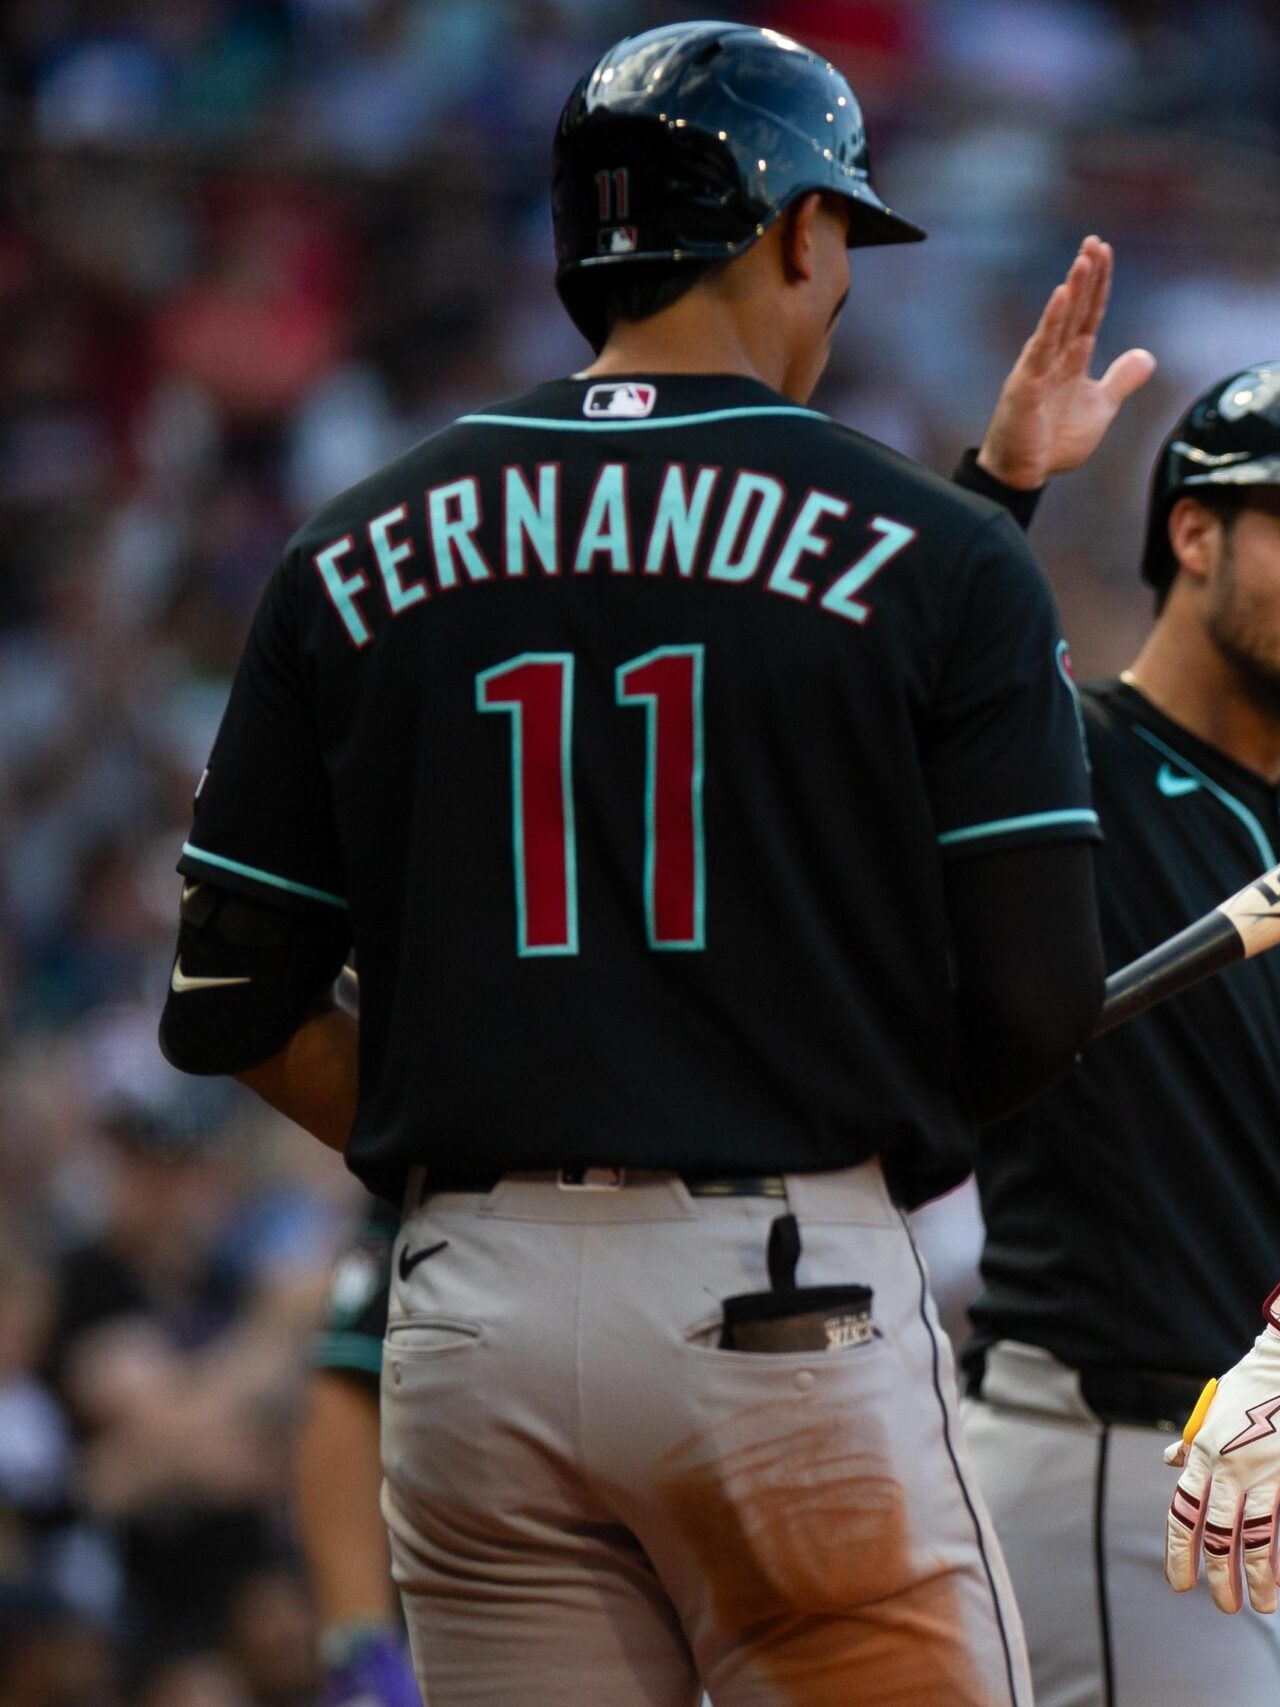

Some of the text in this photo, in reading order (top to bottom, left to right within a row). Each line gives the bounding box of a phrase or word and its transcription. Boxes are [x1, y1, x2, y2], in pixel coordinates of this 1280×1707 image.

[595, 167, 629, 219] 11
[314, 461, 917, 649] FERNANDEZ
[476, 643, 705, 957] 11
